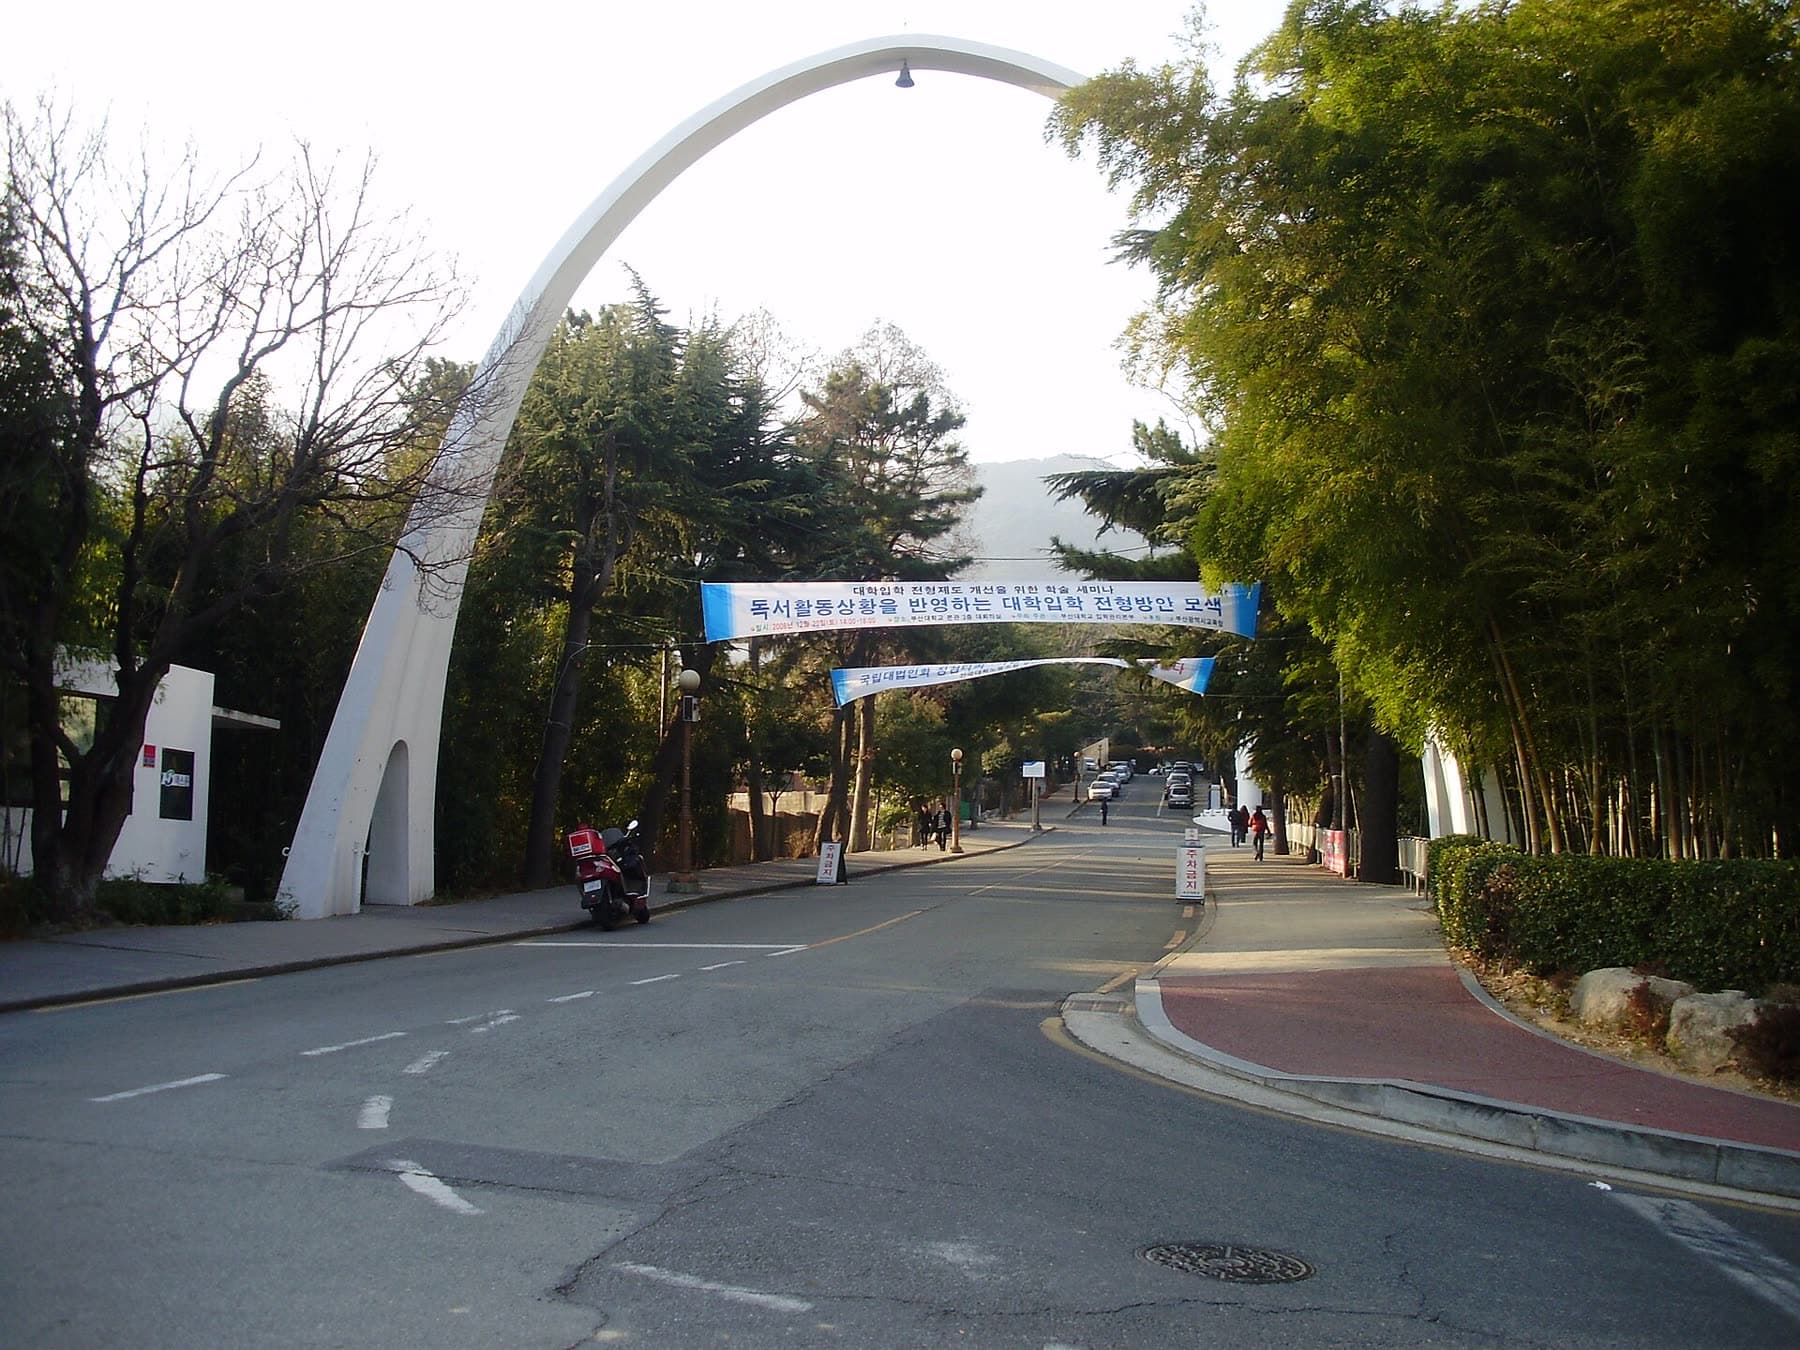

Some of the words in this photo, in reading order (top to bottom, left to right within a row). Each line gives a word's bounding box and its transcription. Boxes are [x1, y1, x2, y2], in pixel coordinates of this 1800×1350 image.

[853, 585, 904, 597] 대학입학
[911, 585, 963, 596] 전형제도
[970, 585, 1007, 595] 개선을
[1014, 585, 1038, 595] 위한
[1046, 585, 1069, 595] 학술
[1077, 585, 1114, 594] 세미나
[750, 598, 898, 620] 독서활동상황을
[909, 596, 992, 613] 반영하는
[1002, 595, 1084, 612] 대학입학
[1094, 596, 1174, 612] 전형방안
[1185, 597, 1222, 617] 모색
[1185, 849, 1198, 889] 주차금지
